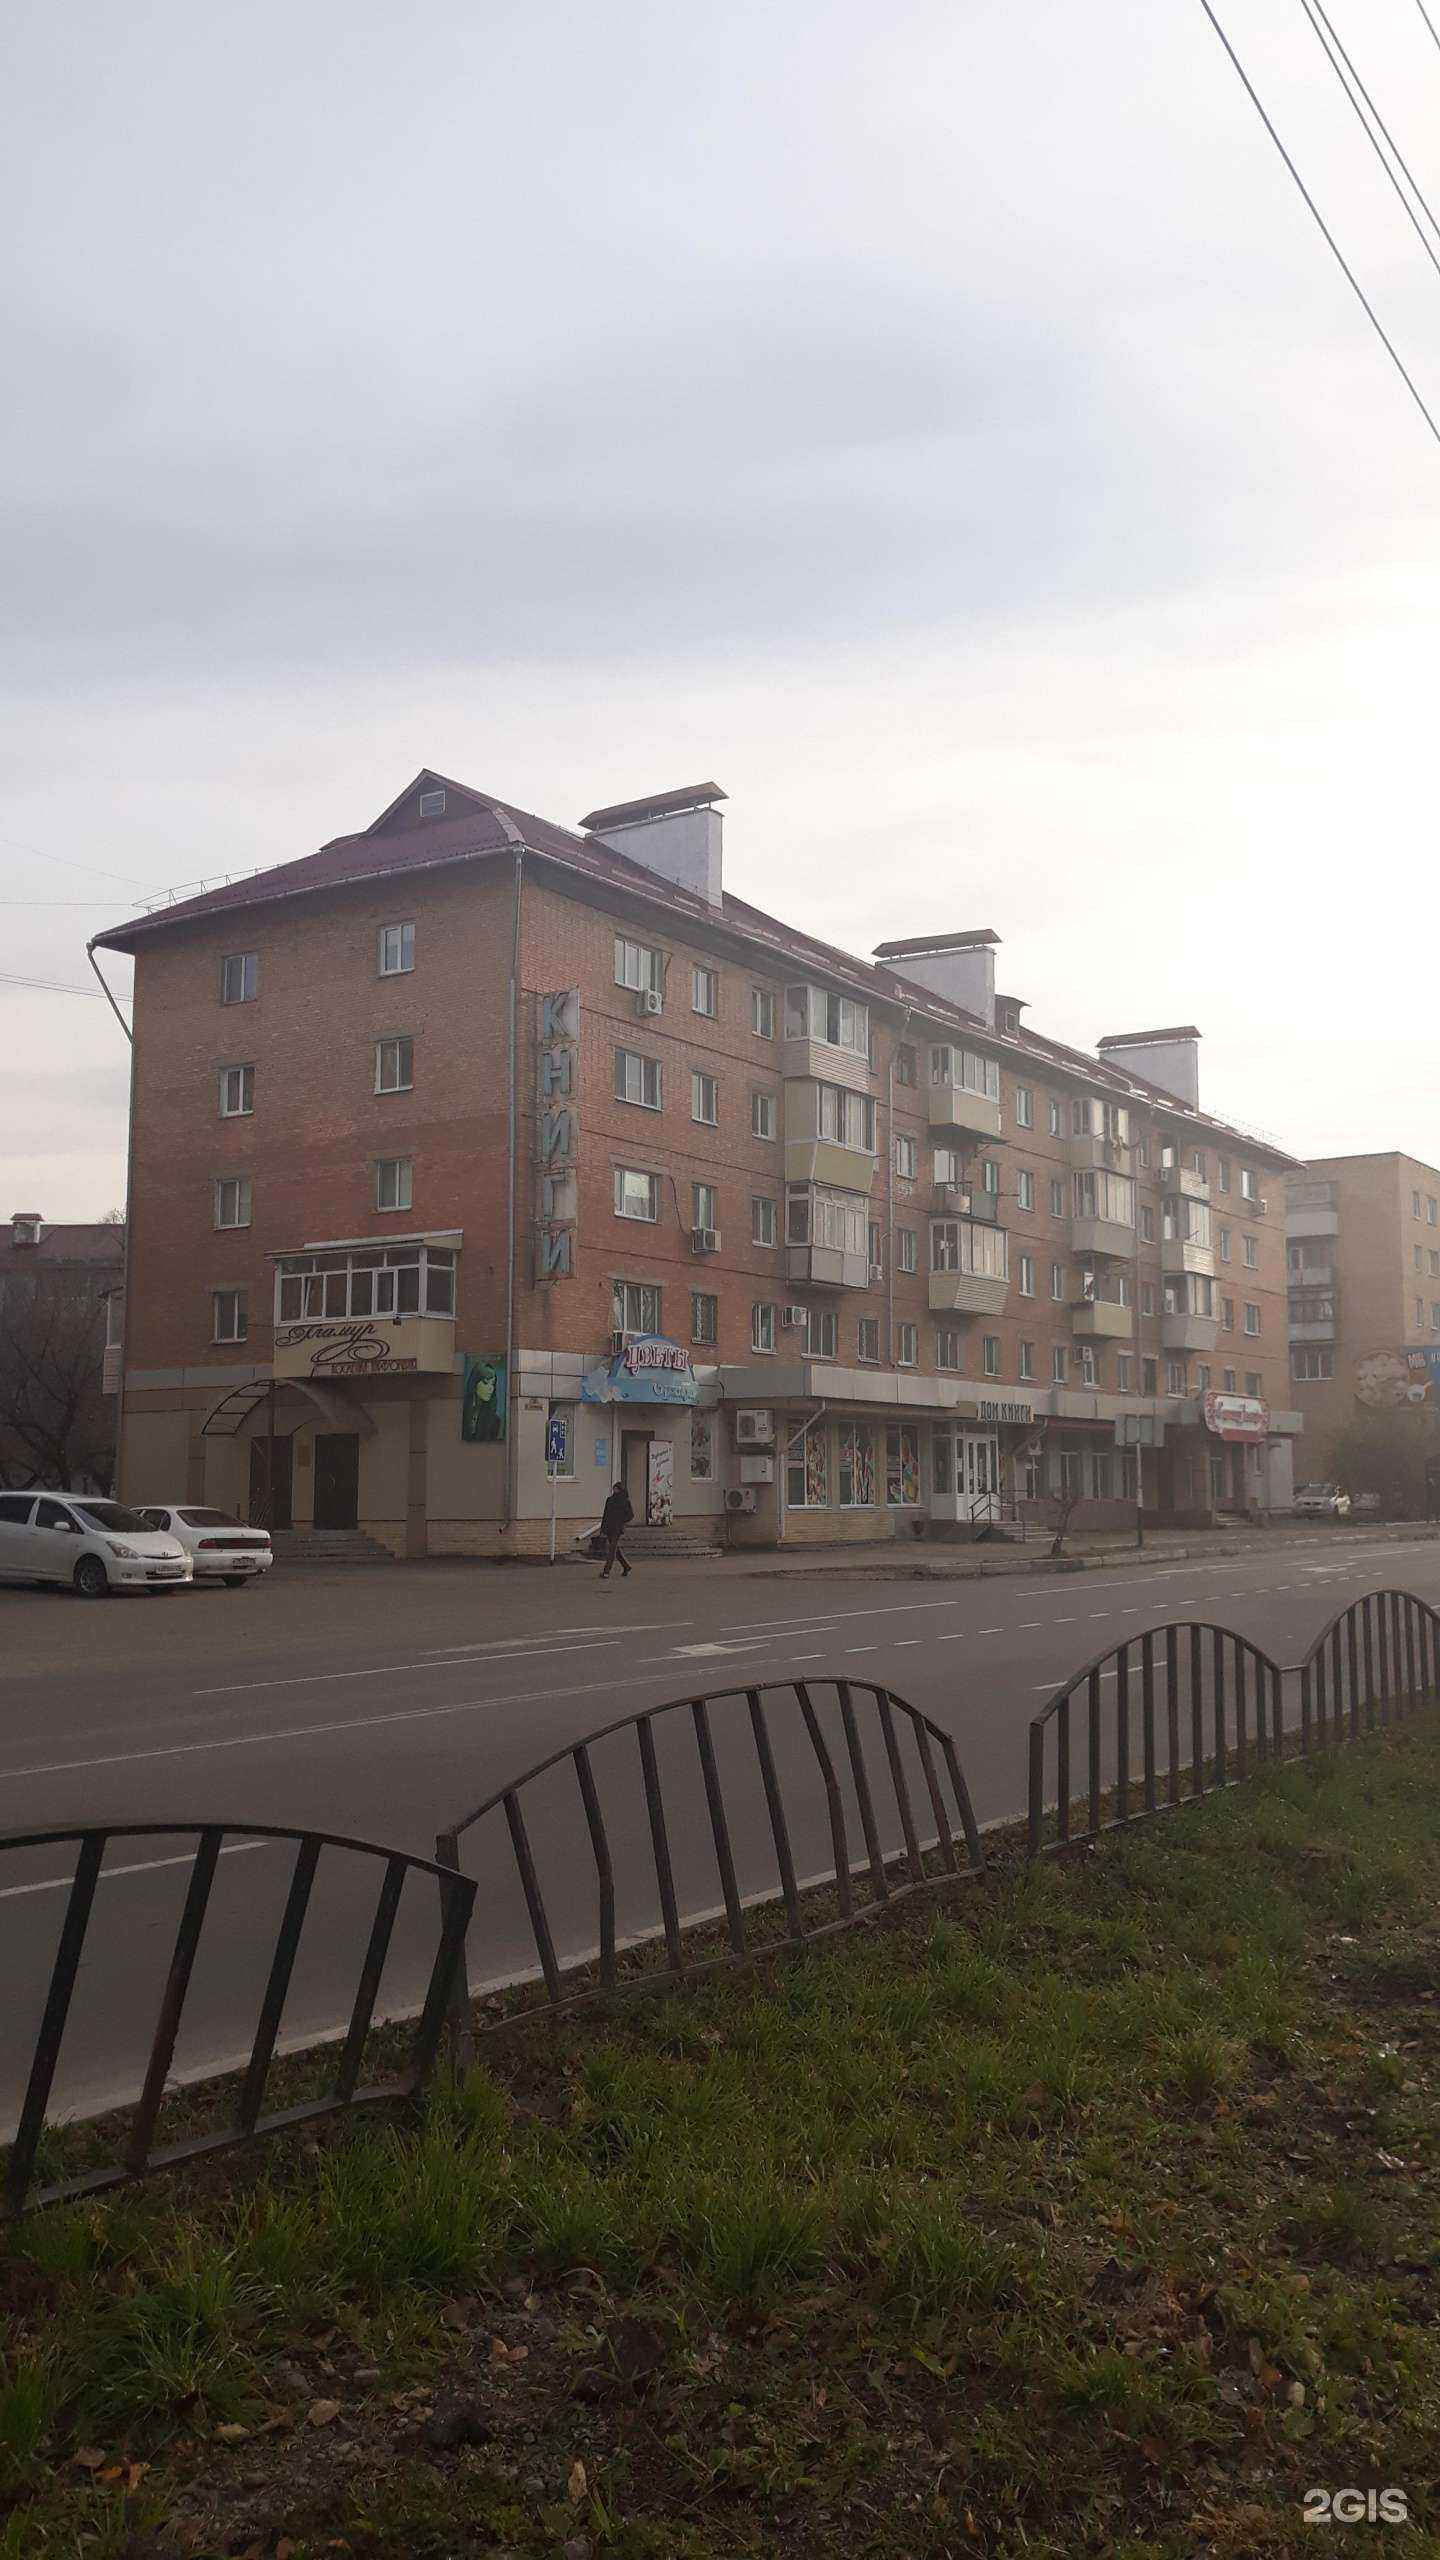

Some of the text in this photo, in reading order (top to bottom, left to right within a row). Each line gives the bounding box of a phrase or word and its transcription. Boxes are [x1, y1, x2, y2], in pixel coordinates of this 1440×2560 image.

[543, 991, 572, 1275] КНИГИ
[275, 1323, 390, 1363] Гламур
[627, 1344, 690, 1376] ЦВЕТЫ
[981, 1400, 999, 1420] ДОМ
